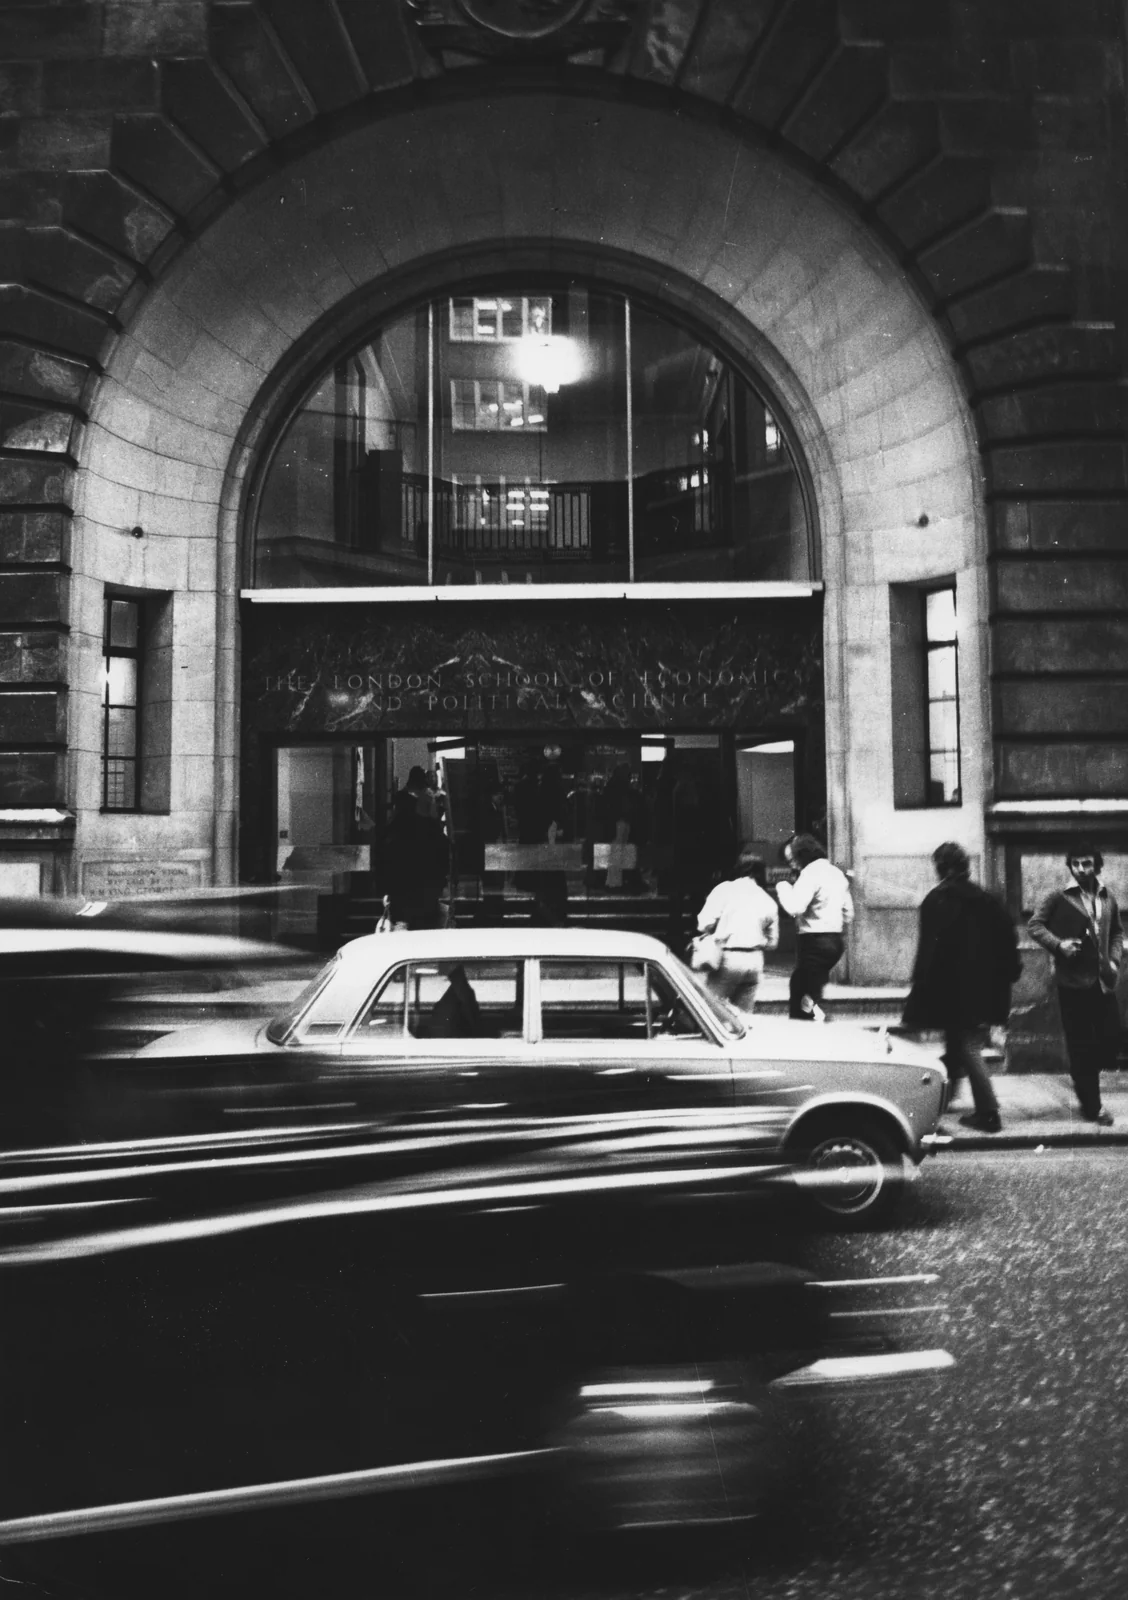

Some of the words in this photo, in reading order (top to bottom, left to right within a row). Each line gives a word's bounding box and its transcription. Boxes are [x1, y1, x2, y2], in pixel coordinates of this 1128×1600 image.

[265, 676, 307, 690] THE
[334, 674, 441, 689] LONDON
[466, 671, 563, 687] SCHOOL
[589, 671, 618, 686] OF
[643, 669, 802, 686] ECONOMICS
[352, 695, 402, 711] ND
[428, 694, 566, 710] POLITICAL
[597, 692, 718, 708] SCIENCE
